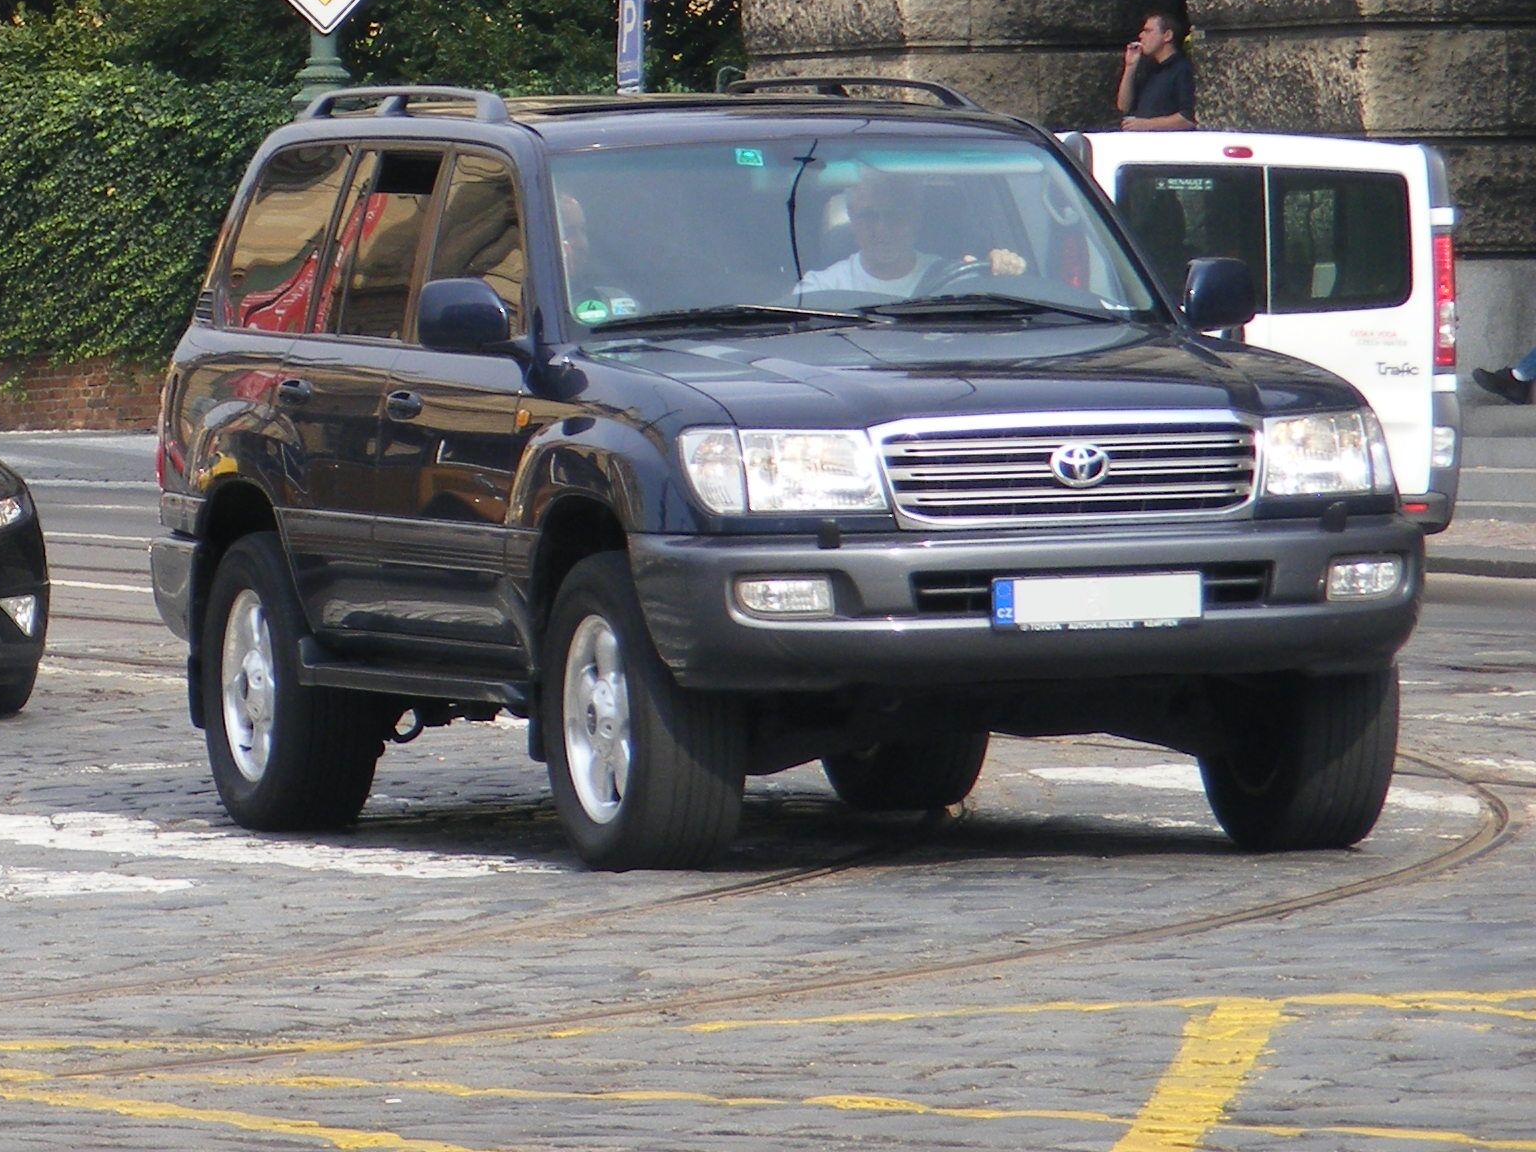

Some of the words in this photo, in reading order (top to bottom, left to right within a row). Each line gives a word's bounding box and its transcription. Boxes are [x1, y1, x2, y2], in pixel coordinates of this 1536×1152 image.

[623, 0, 636, 53] P
[1376, 362, 1419, 375] Trafic
[997, 608, 1013, 618] CZ
[1030, 622, 1062, 631] TOYOTA
